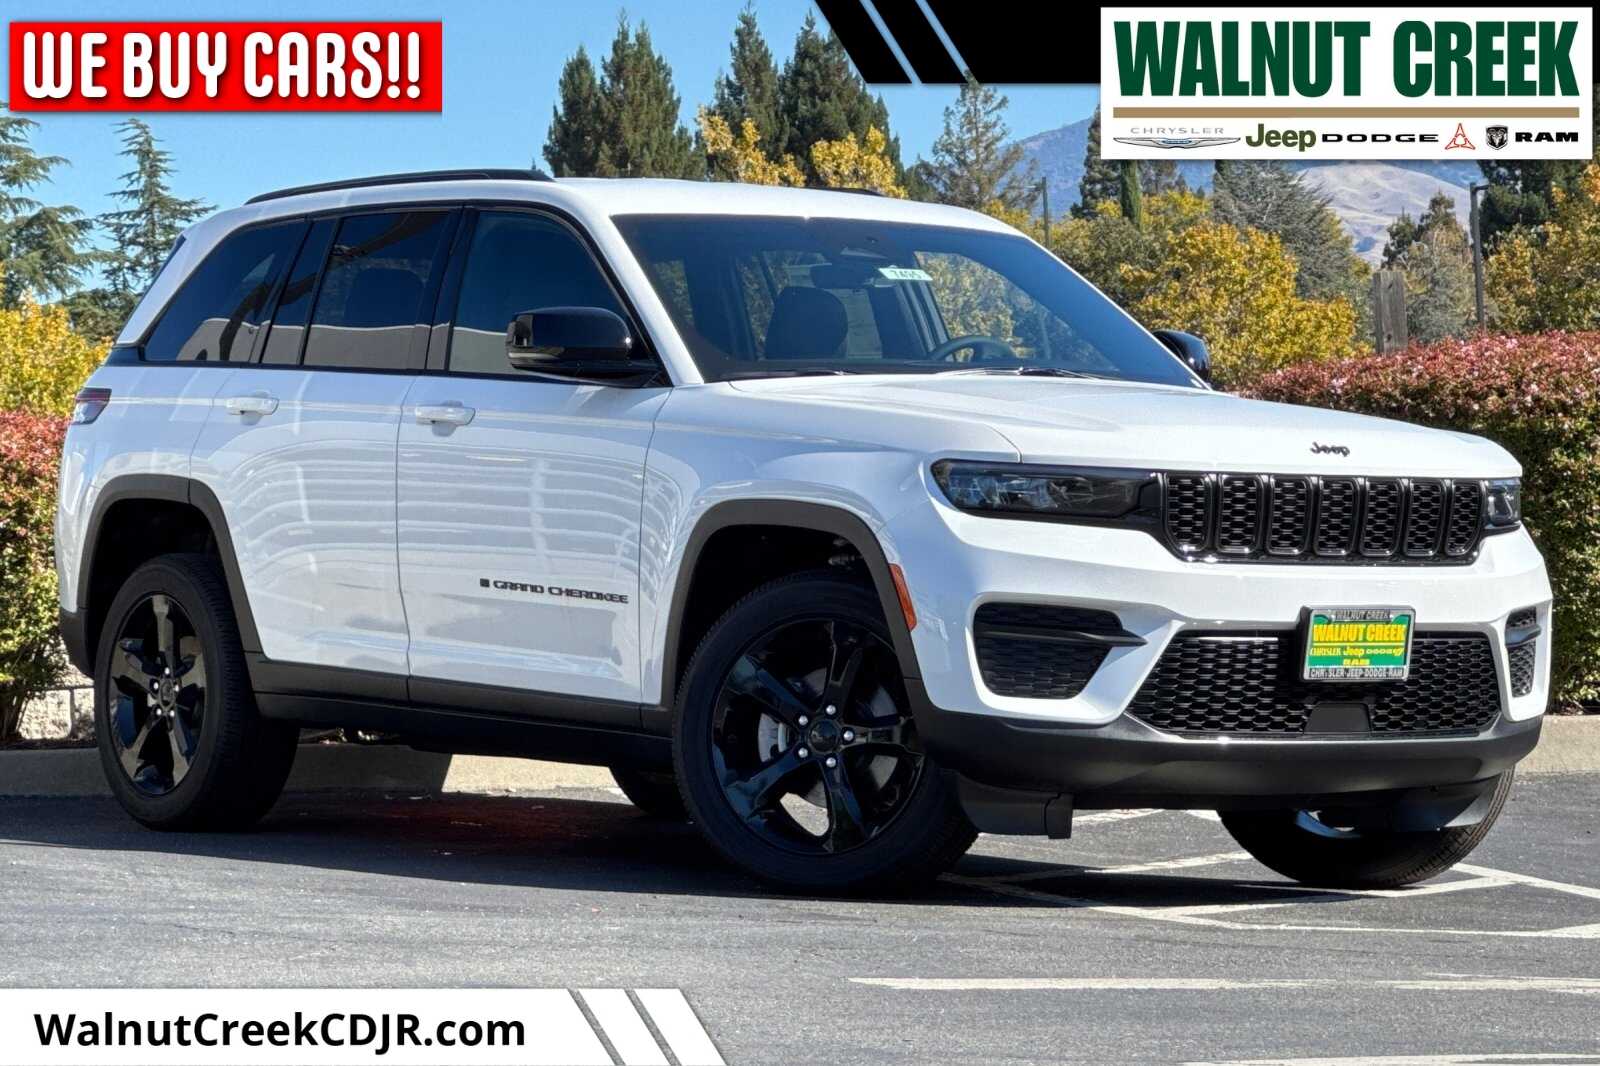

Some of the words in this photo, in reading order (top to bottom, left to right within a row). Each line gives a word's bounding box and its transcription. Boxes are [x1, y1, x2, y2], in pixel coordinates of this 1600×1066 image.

[493, 580, 544, 594] GRAND
[547, 586, 629, 604] CHEROKEE
[1335, 610, 1366, 620] WALNUT
[1313, 624, 1366, 642] WALNUT
[1366, 624, 1407, 642] CREEK
